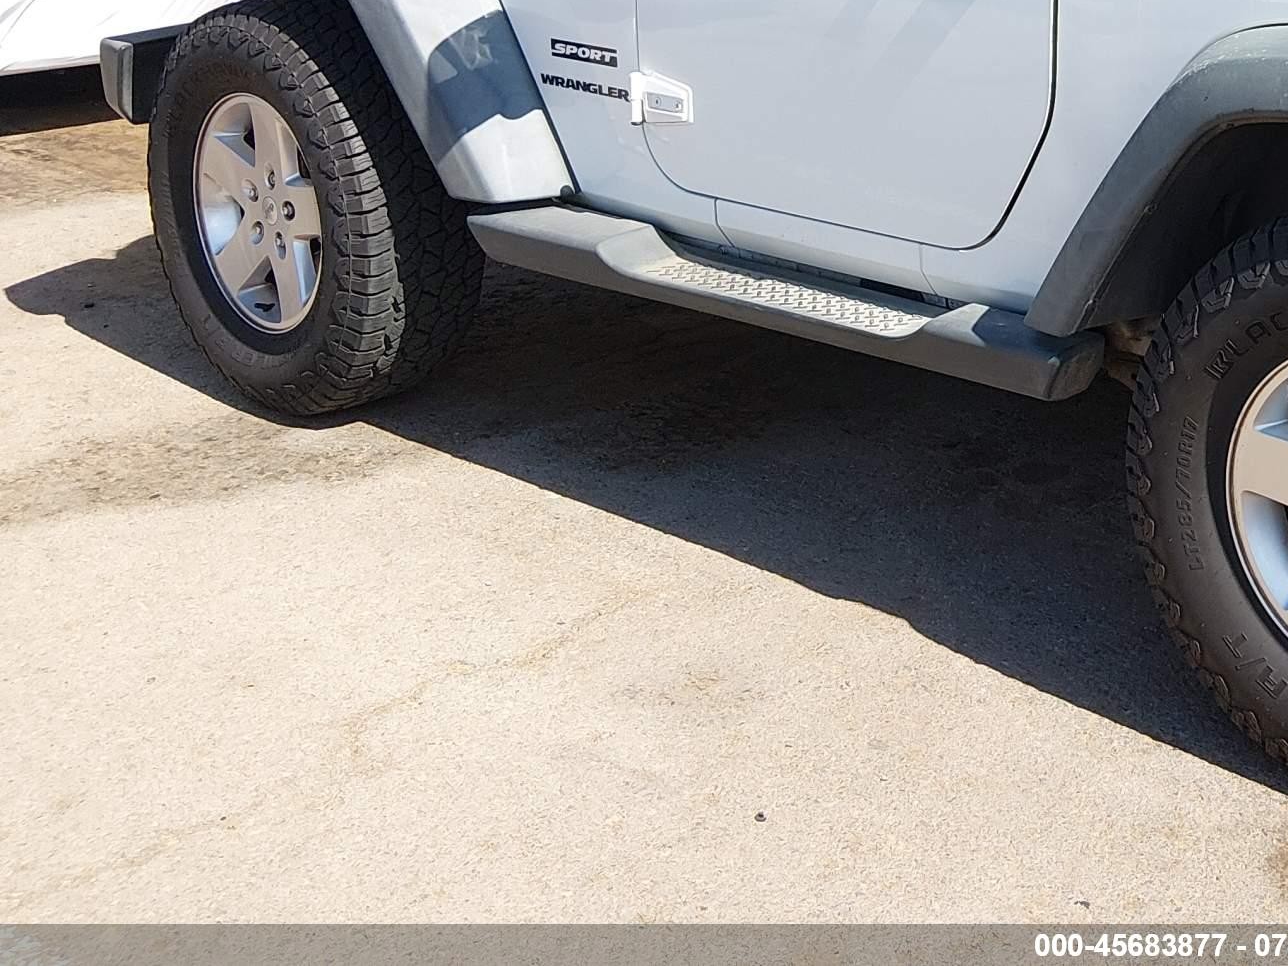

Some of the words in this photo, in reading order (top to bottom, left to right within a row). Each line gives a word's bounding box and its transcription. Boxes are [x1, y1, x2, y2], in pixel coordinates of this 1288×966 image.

[551, 41, 618, 63] SPORT
[540, 72, 631, 103] WRANGLER
[1222, 633, 1288, 699] A/T
